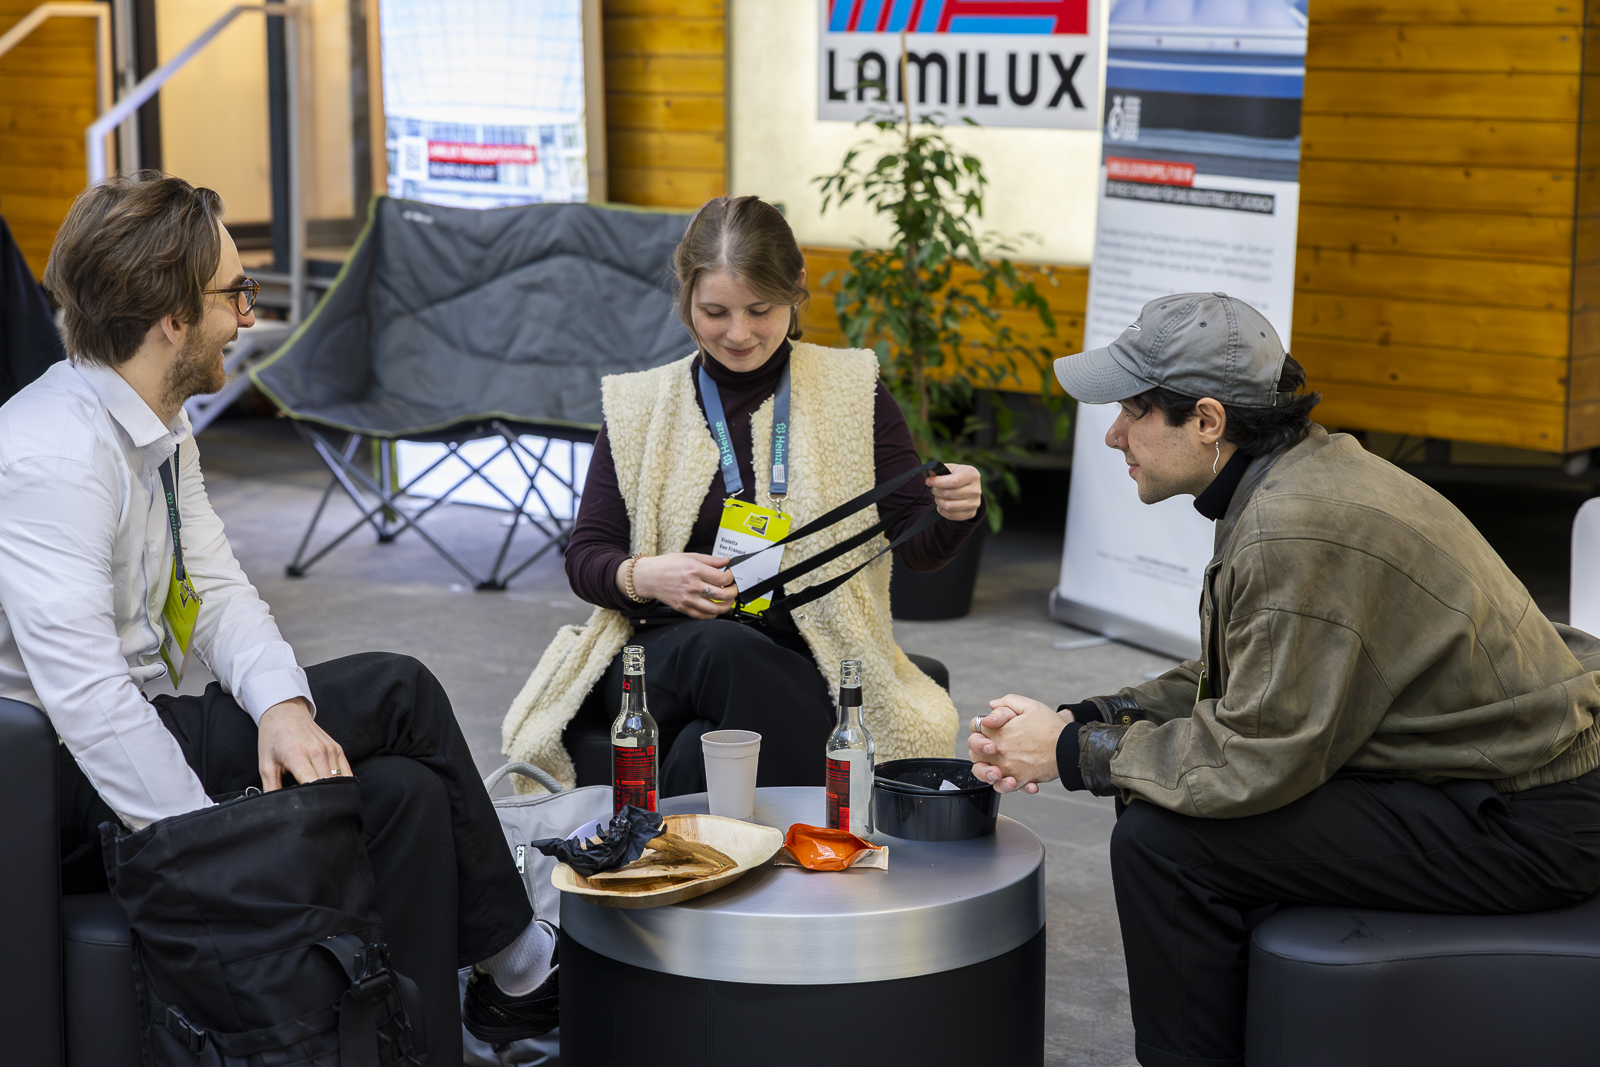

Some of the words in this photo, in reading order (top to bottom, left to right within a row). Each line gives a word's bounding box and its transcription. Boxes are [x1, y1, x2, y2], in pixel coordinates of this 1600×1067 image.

[828, 49, 1086, 109] LAMILUX
[715, 421, 731, 455] Heinze
[168, 507, 178, 547] Heinze
